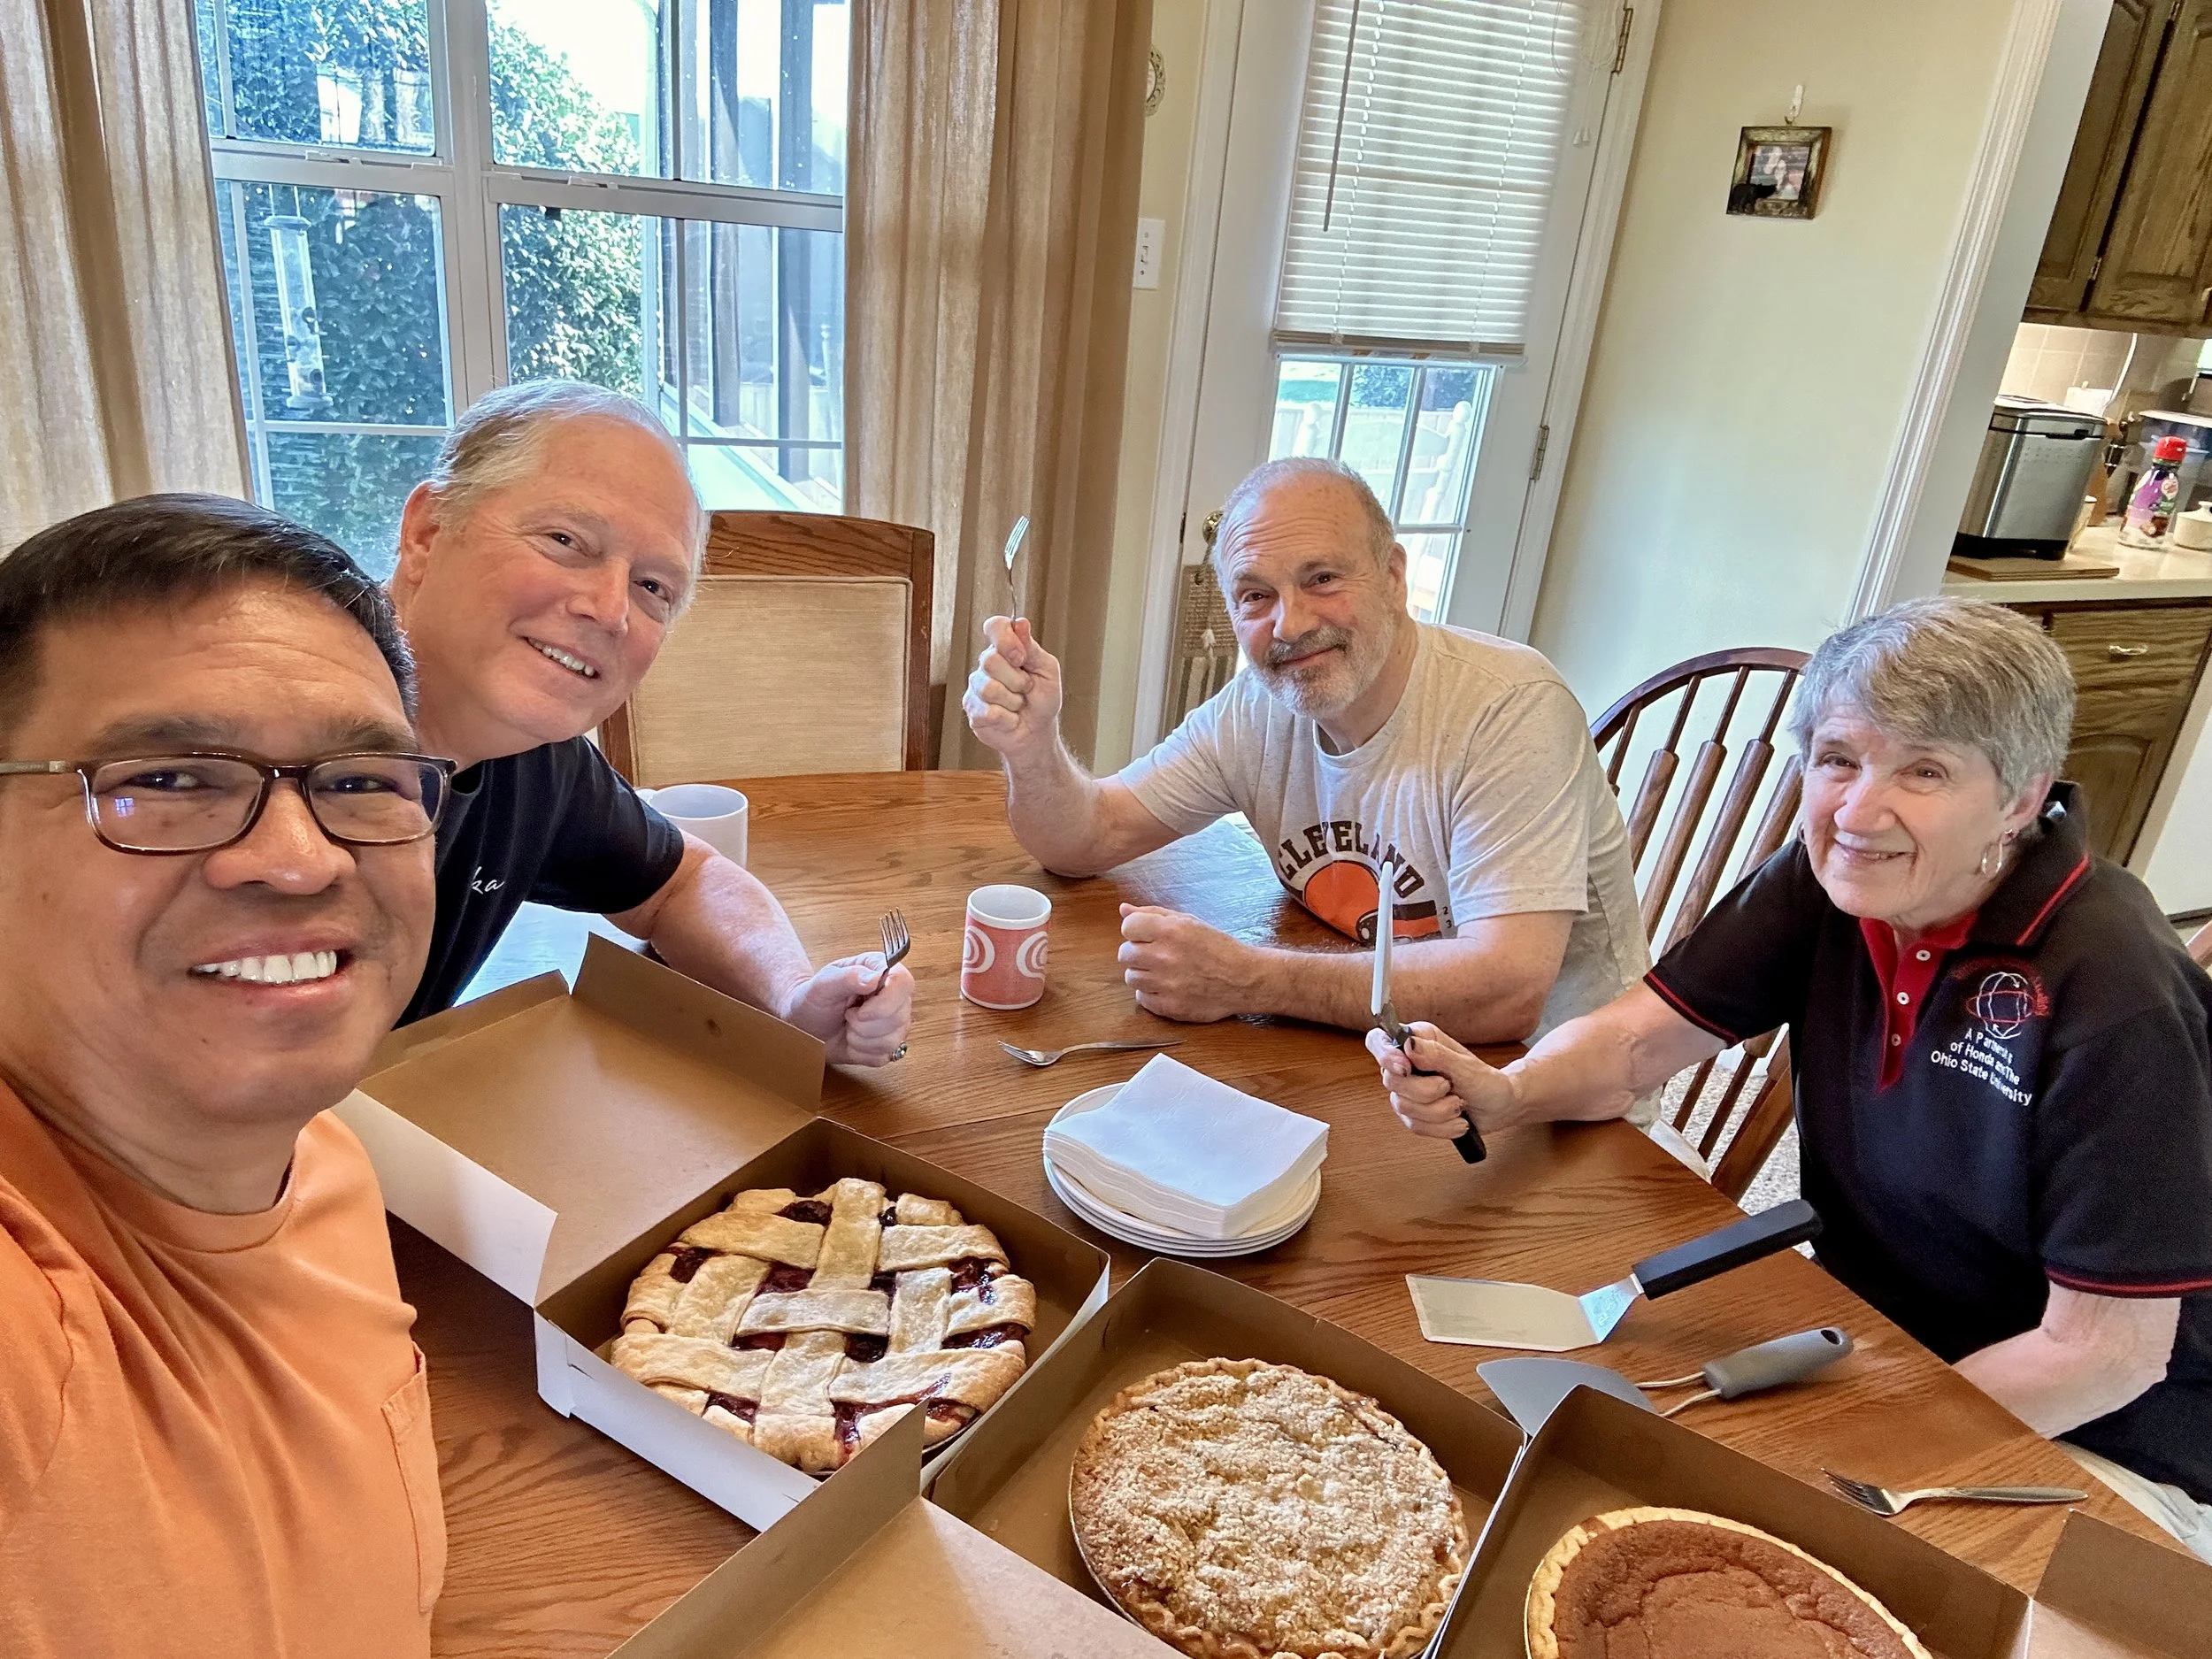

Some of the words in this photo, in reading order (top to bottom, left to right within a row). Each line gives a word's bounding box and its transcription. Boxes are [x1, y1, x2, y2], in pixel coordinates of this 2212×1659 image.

[1442, 906, 1448, 915] 2
[1446, 919, 1452, 929] 3
[1964, 1027, 1972, 1041] A
[1931, 1050, 1958, 1068] Ohio
[1960, 1059, 1989, 1080] State
[1950, 1041, 1964, 1055] of
[1965, 1044, 1994, 1067] Honda
[2004, 1065, 2020, 1085] The
